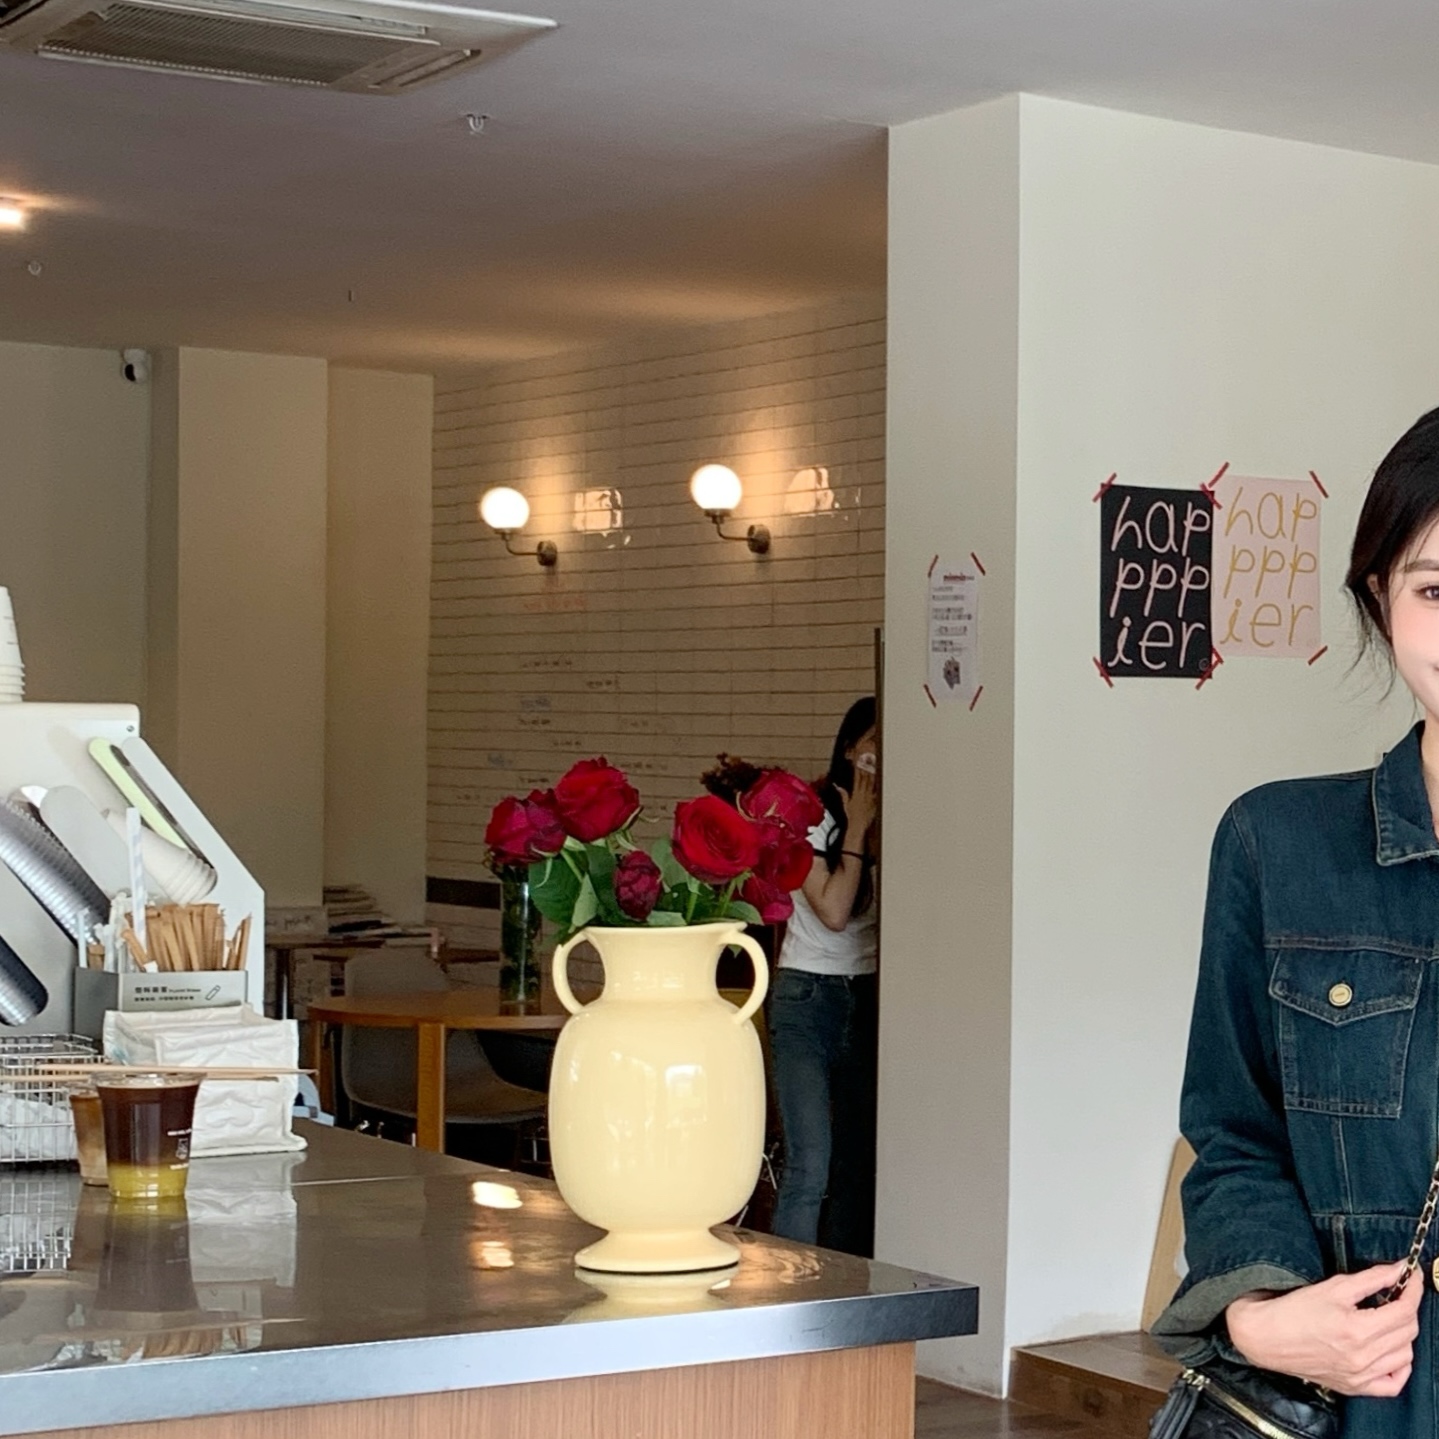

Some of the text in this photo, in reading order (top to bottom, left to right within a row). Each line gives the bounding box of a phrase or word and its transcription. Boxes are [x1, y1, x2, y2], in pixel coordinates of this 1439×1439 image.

[1111, 495, 1210, 557] hap
[1225, 486, 1317, 542] hap
[1109, 557, 1209, 618] ppp
[1224, 544, 1317, 599] ppp
[1107, 616, 1205, 670] ier
[1219, 598, 1313, 648] ier
